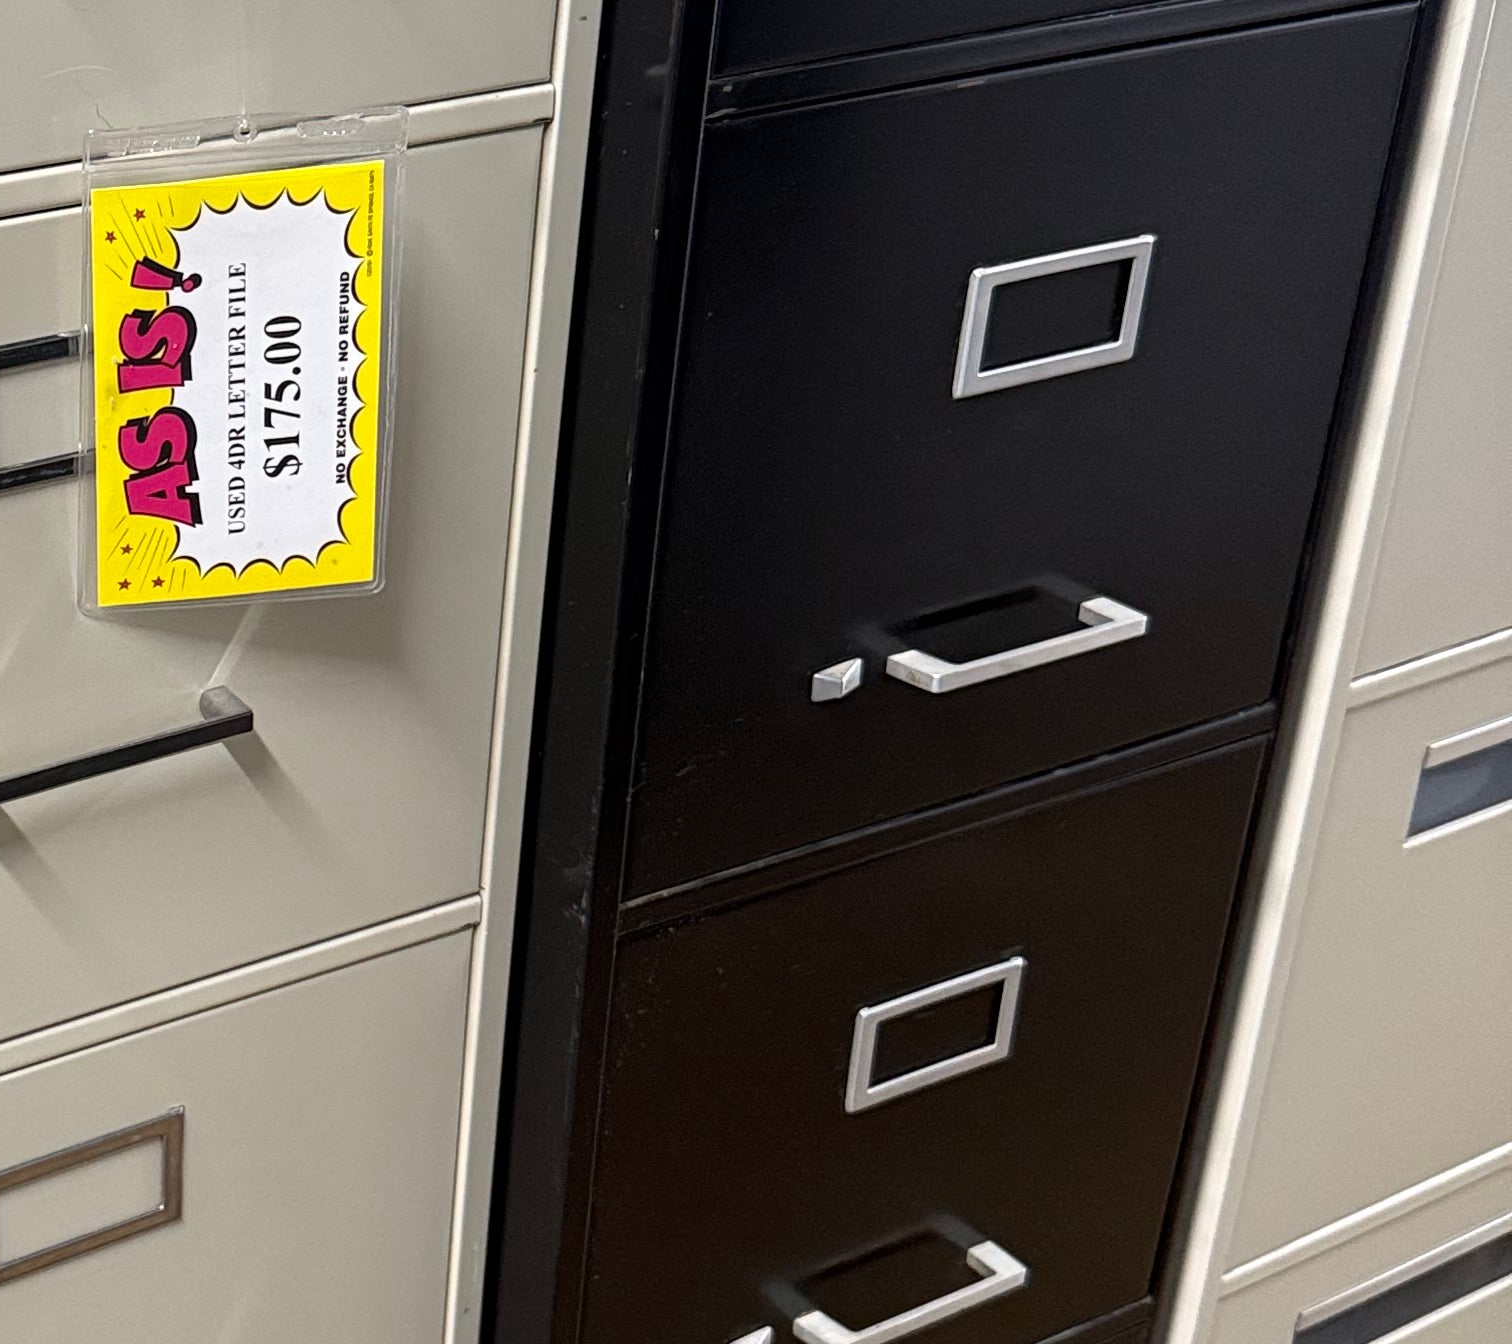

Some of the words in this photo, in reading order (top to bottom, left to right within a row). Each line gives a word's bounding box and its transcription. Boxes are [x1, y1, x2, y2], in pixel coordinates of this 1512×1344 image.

[228, 262, 246, 320] FILE
[339, 271, 351, 335] REFUND
[228, 325, 246, 420] LETTER
[339, 341, 349, 361] NO
[262, 316, 303, 478] $175.00
[336, 375, 348, 458] EXCHANGE
[118, 406, 203, 528] AS
[228, 426, 246, 470] 4DR
[336, 462, 346, 484] NO
[228, 477, 246, 535] USED
